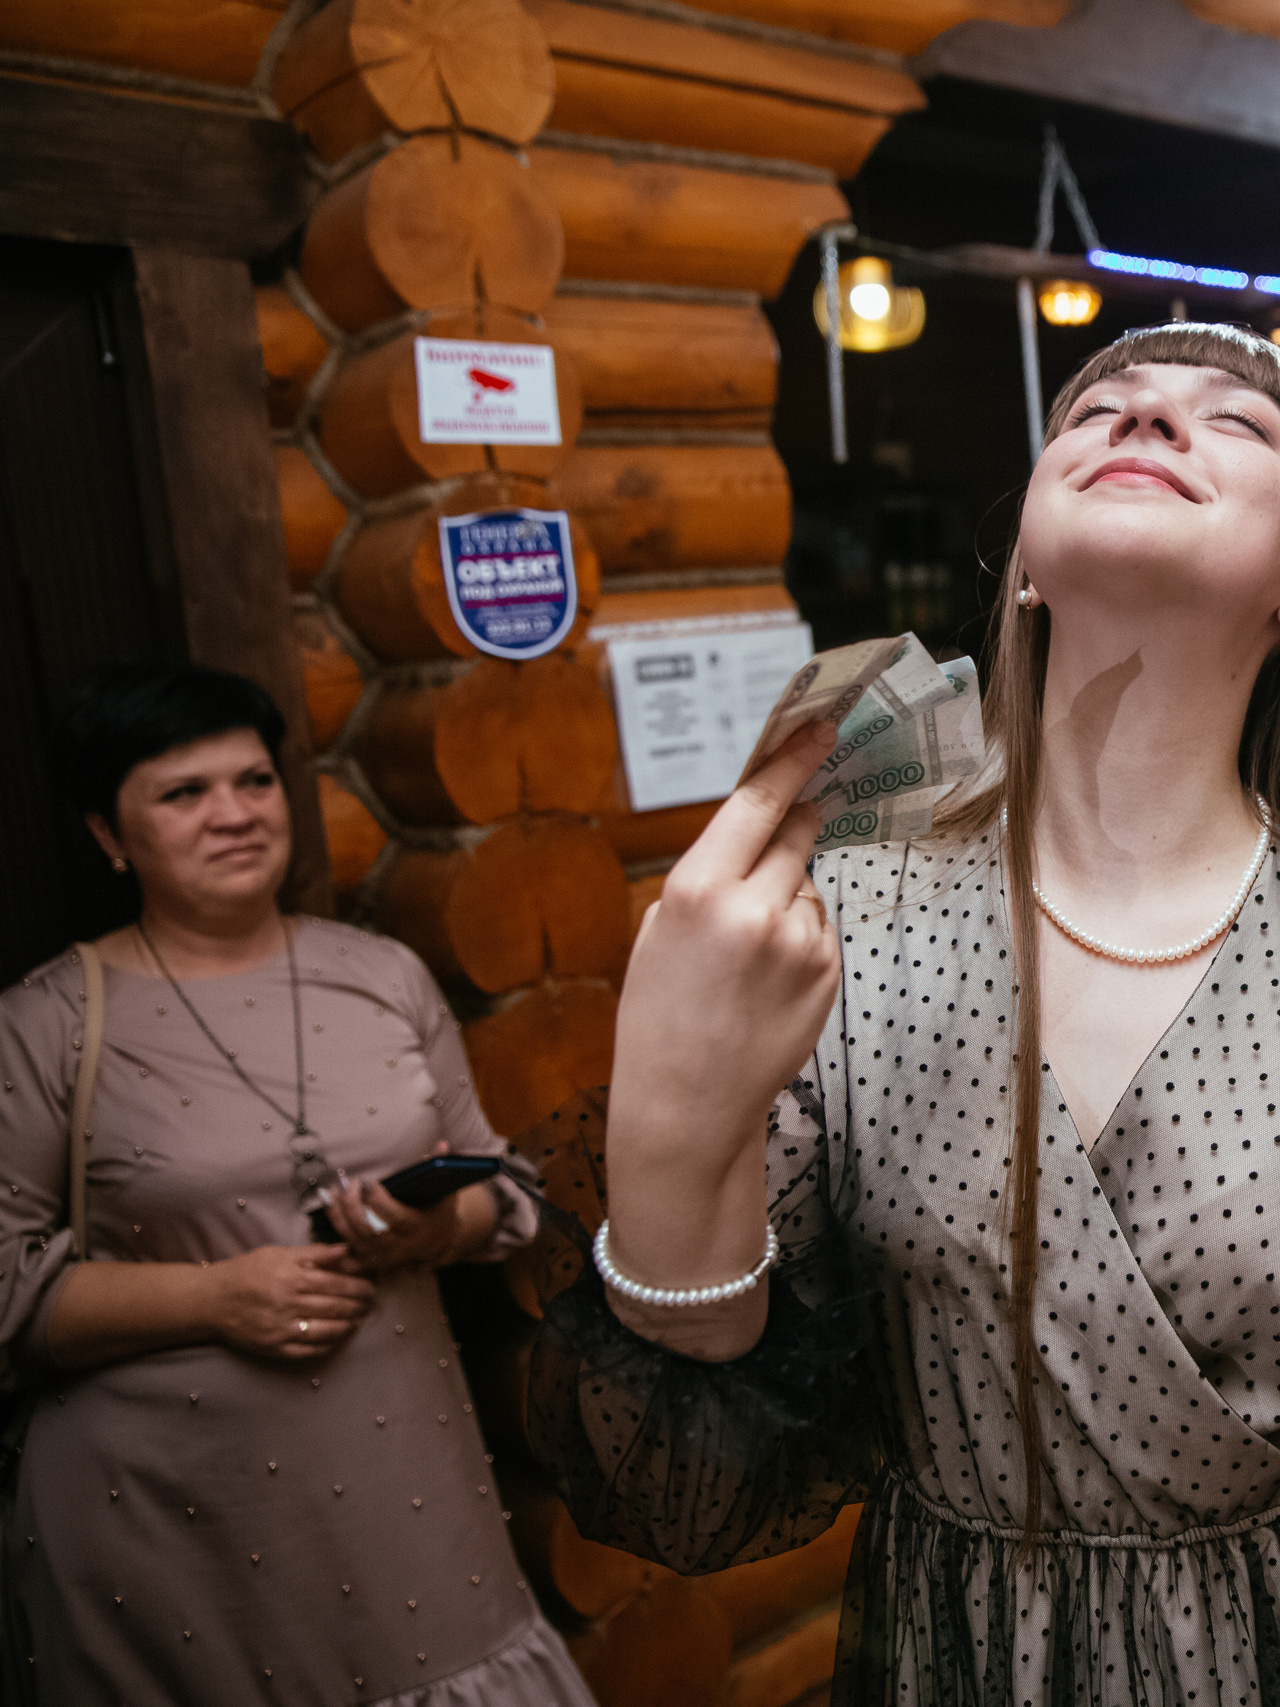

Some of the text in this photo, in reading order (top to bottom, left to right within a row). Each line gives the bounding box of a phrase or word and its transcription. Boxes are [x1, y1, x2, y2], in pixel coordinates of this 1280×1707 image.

[457, 556, 559, 584] ОБЪЕКТ
[820, 714, 894, 774] 1000
[841, 761, 925, 805] 1000
